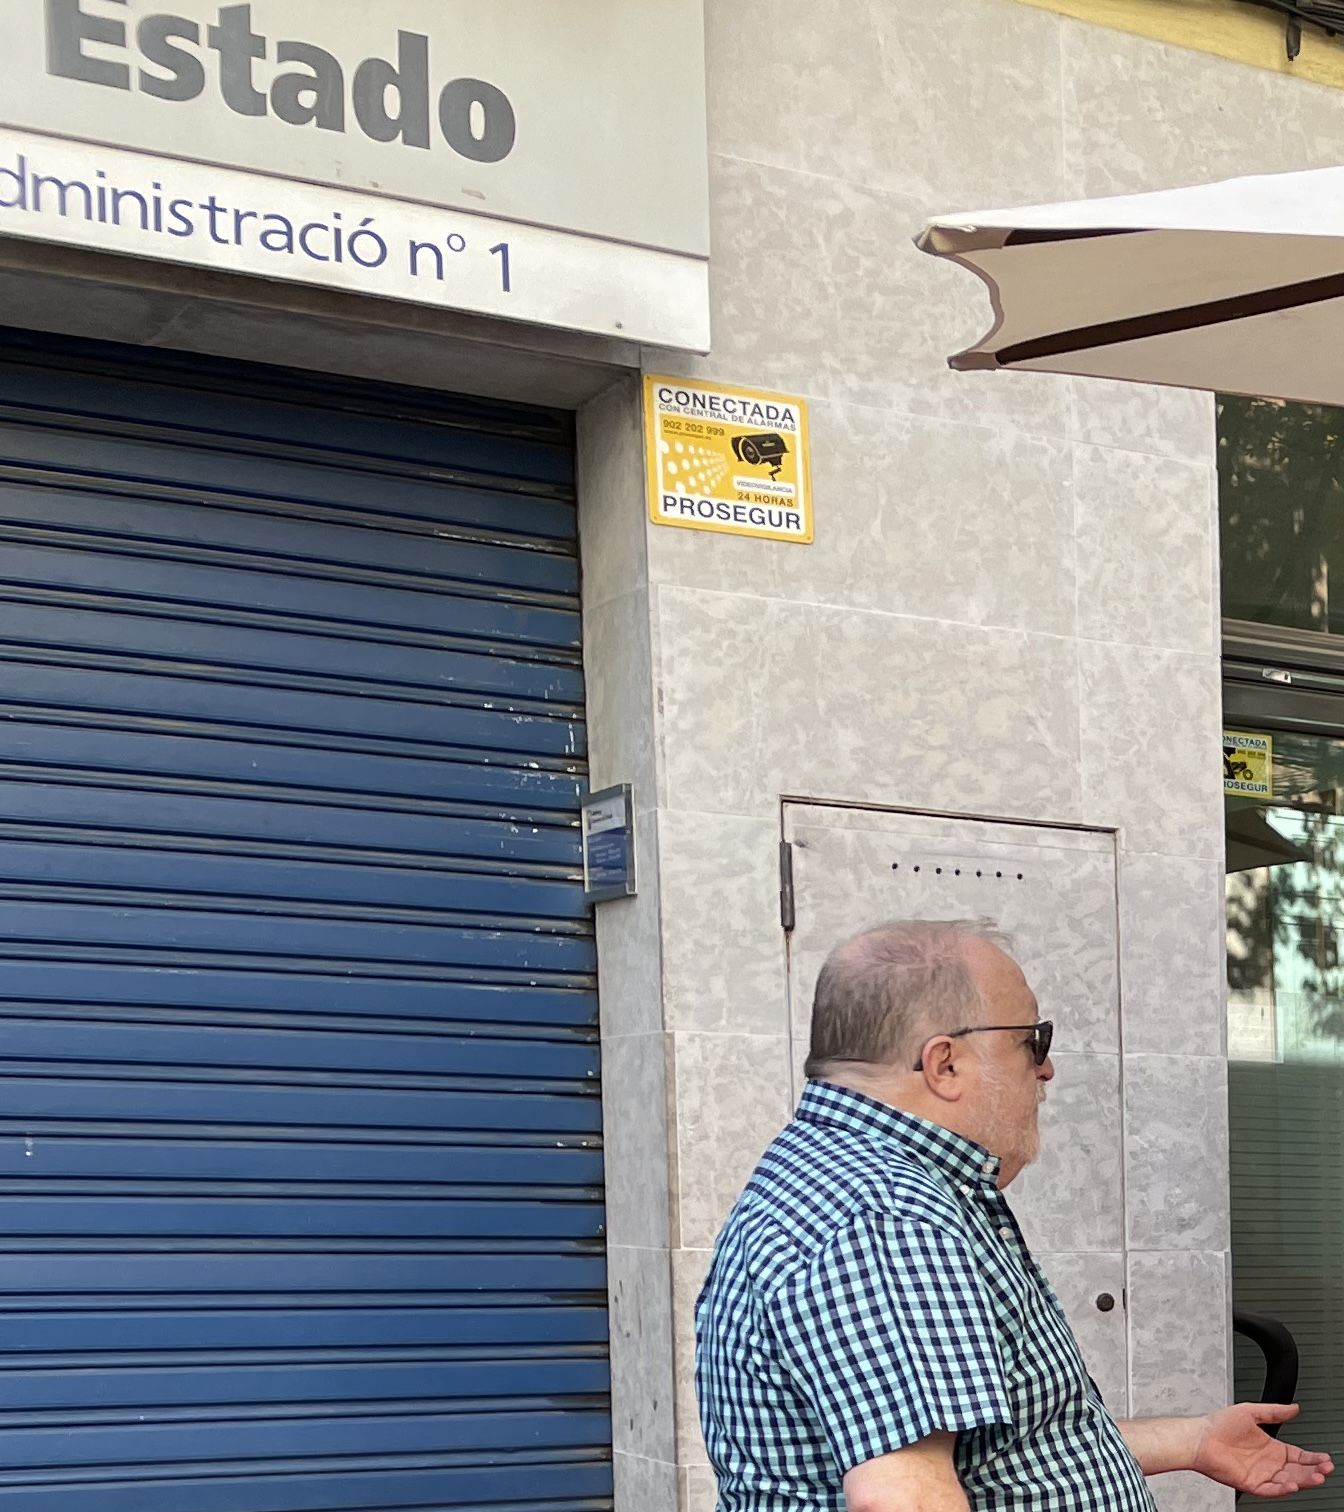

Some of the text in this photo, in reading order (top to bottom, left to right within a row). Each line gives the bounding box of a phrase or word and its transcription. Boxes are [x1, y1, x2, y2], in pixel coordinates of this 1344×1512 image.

[45, 0, 516, 163] Estado
[489, 243, 512, 292] 1
[658, 387, 796, 424] CONECTADA
[658, 403, 796, 432] CON CENTRAL DE ALARMAS
[663, 495, 801, 530] PROSEGUR
[738, 491, 794, 507] 24 HORAS
[1223, 735, 1267, 747] NECTADA
